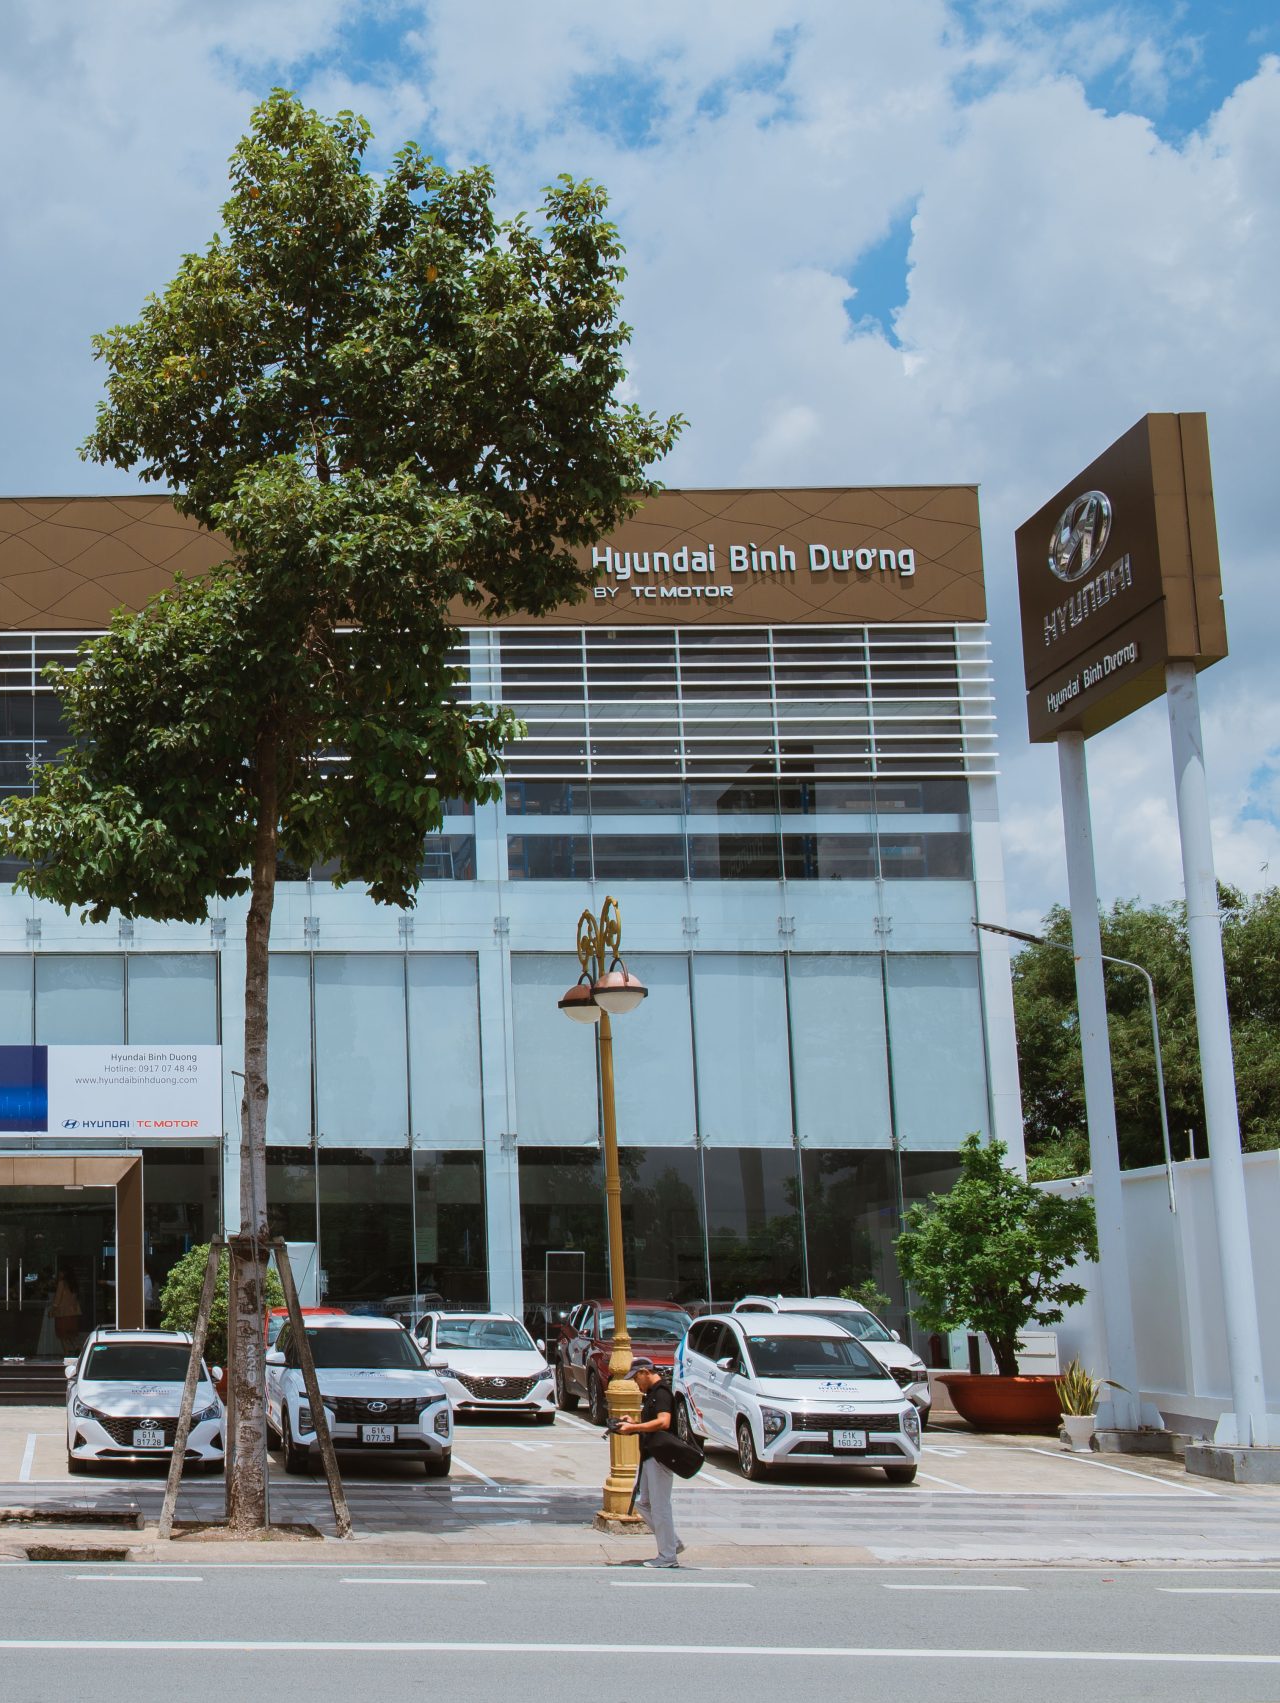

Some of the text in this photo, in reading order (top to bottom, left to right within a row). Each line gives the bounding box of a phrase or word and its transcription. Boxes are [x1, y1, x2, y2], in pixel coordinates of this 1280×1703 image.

[592, 544, 715, 580] Hyundai
[808, 544, 916, 576] Dương
[593, 585, 734, 598] BY TC MOTOR
[1043, 552, 1133, 647] HYUNDAI
[1047, 673, 1080, 713] Hyundai
[111, 1053, 197, 1063] Hyundai Binh Duong
[104, 1064, 198, 1073] Hotline: 0917 07 48 49
[74, 1075, 198, 1086] www.hyundaibinhduong.com
[82, 1120, 199, 1128] HYUNDAI TC MOTOR
[371, 1426, 385, 1434] 61K
[142, 1431, 156, 1439] 61A
[842, 1431, 856, 1439] 61K
[136, 1438, 162, 1446] 917.28
[838, 1439, 863, 1447] 160.23
